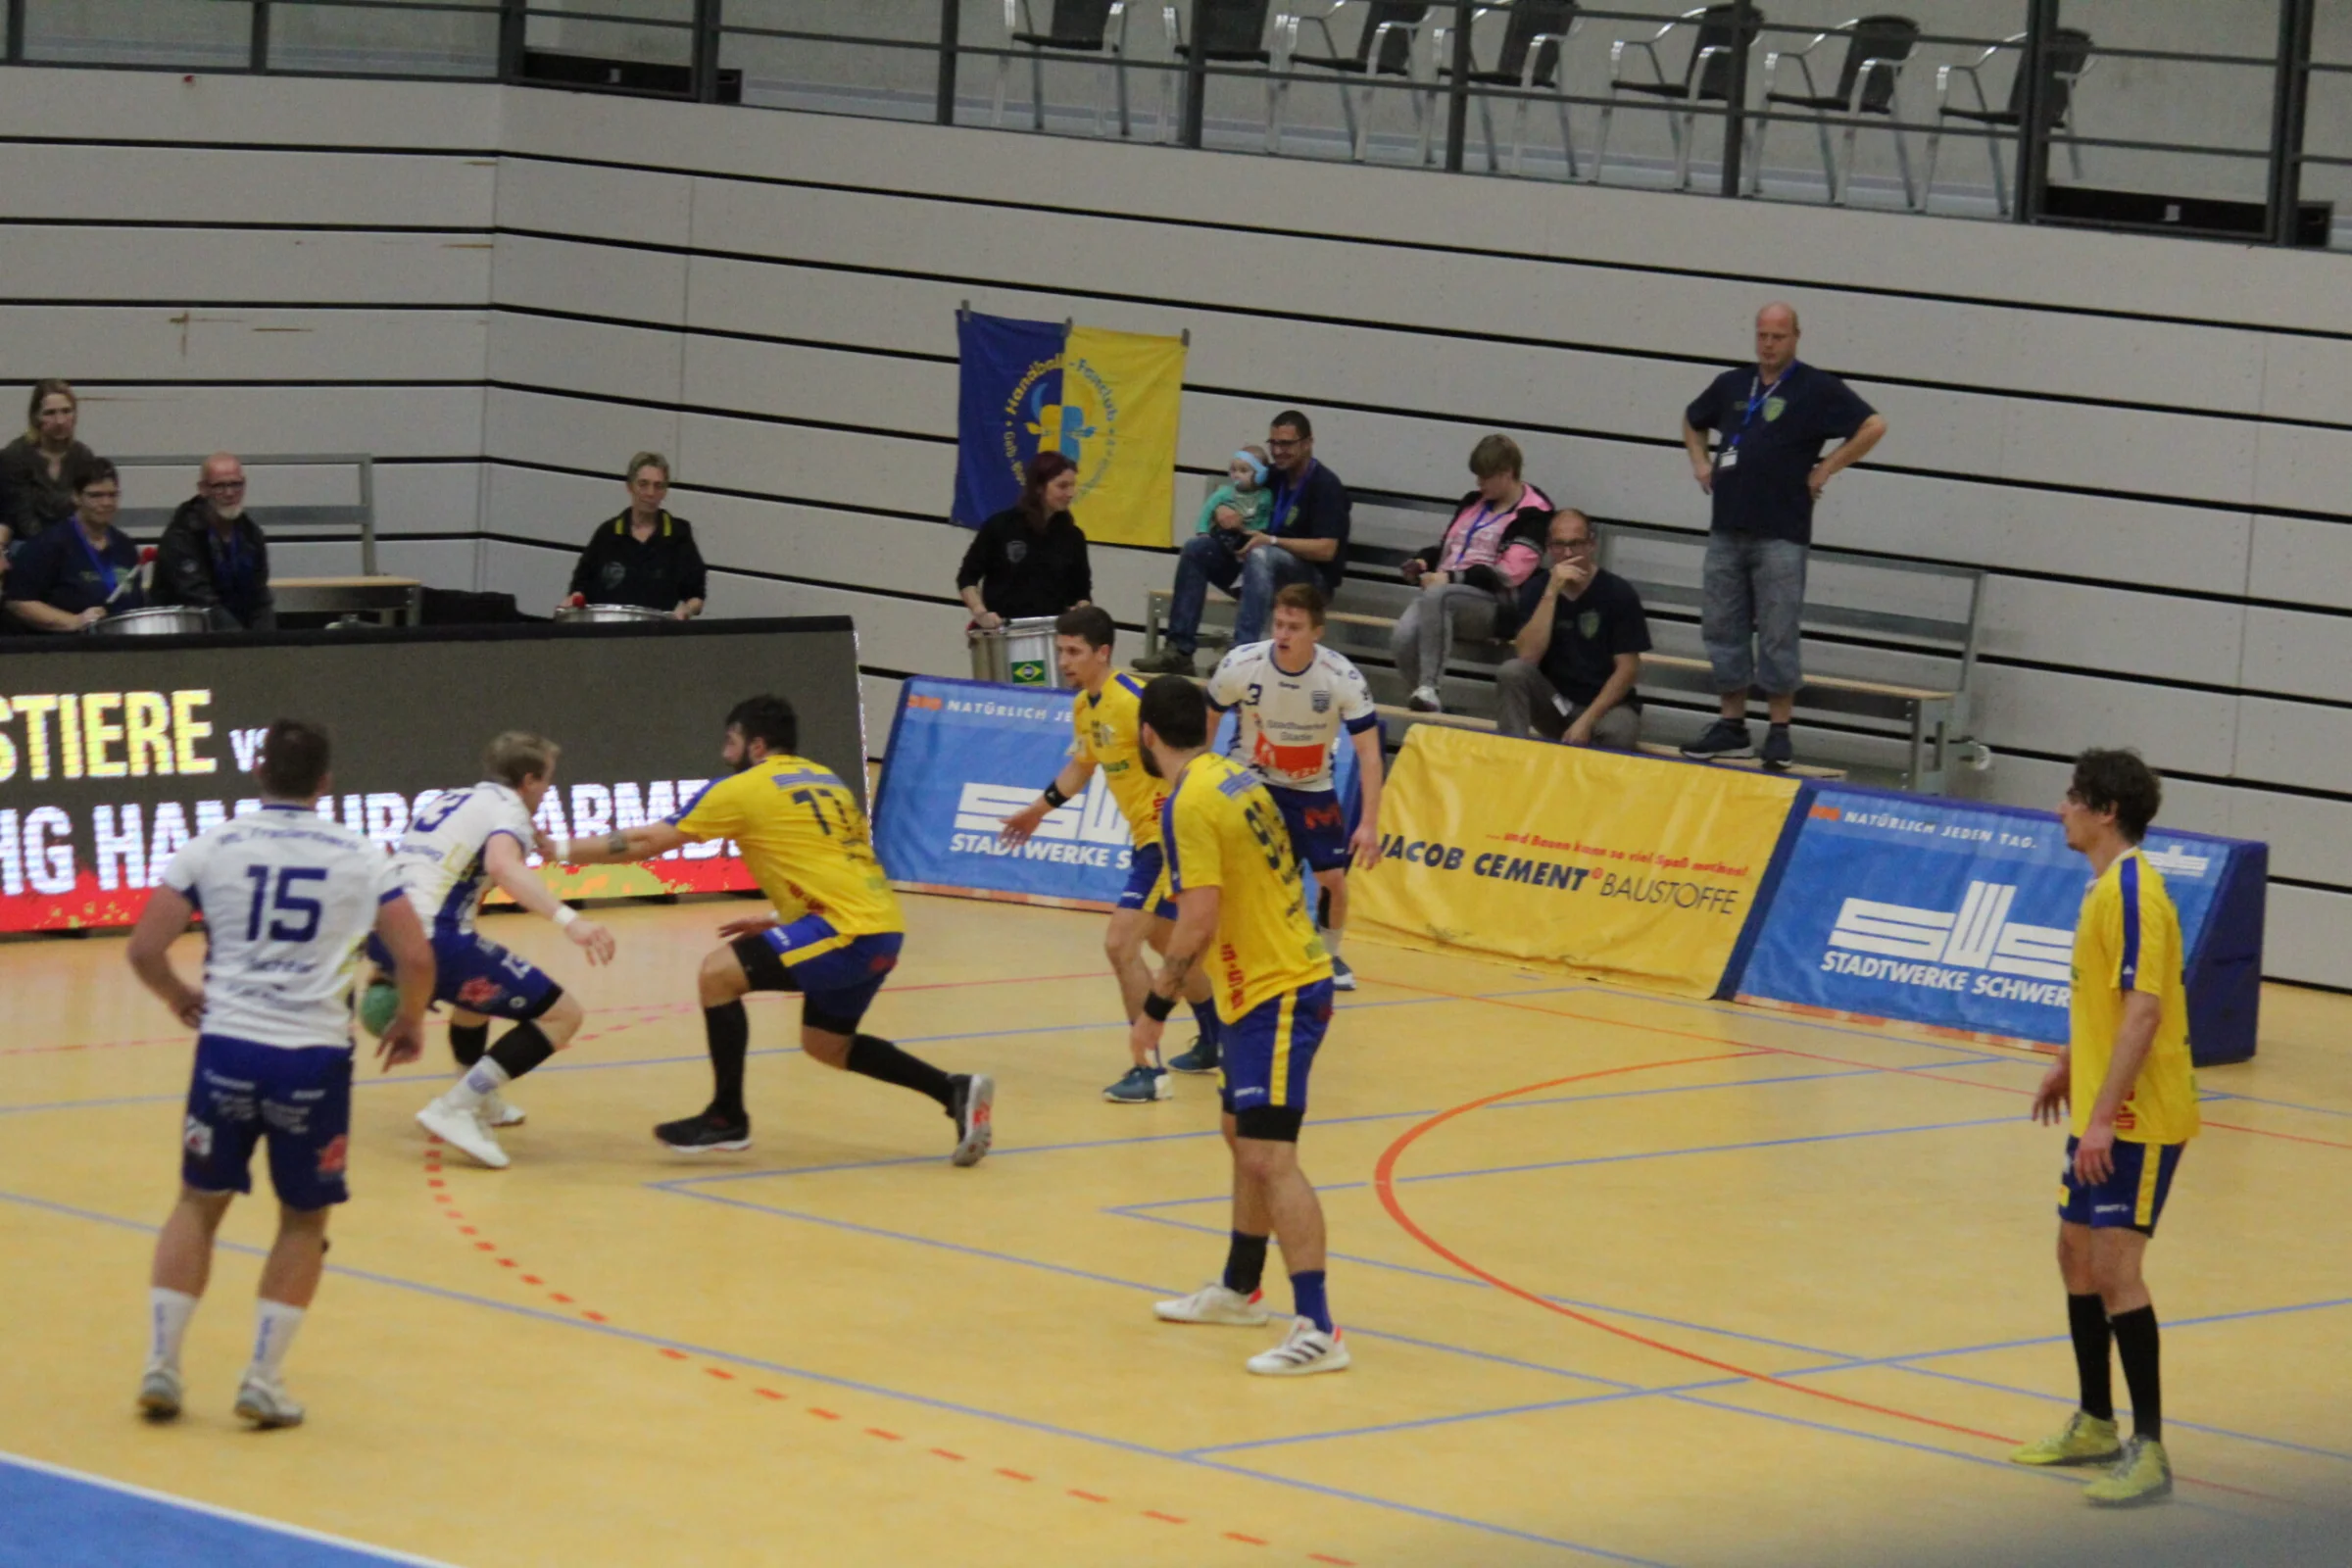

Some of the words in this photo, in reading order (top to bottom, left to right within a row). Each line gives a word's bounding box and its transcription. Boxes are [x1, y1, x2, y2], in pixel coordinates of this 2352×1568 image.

[947, 699, 1048, 720] NATÜRLICH
[1054, 710, 1074, 723] JE
[1843, 809, 1936, 835] NATÜRLICH
[1940, 825, 1993, 843] JEDEN
[1380, 833, 1465, 870] JACOB
[1473, 852, 1590, 892] CEMENT
[1599, 872, 1740, 915] BAUSTOFFE
[246, 863, 328, 944] 15
[1820, 950, 1970, 993] STADTWERKE
[1971, 974, 2072, 1008] SCHWER
